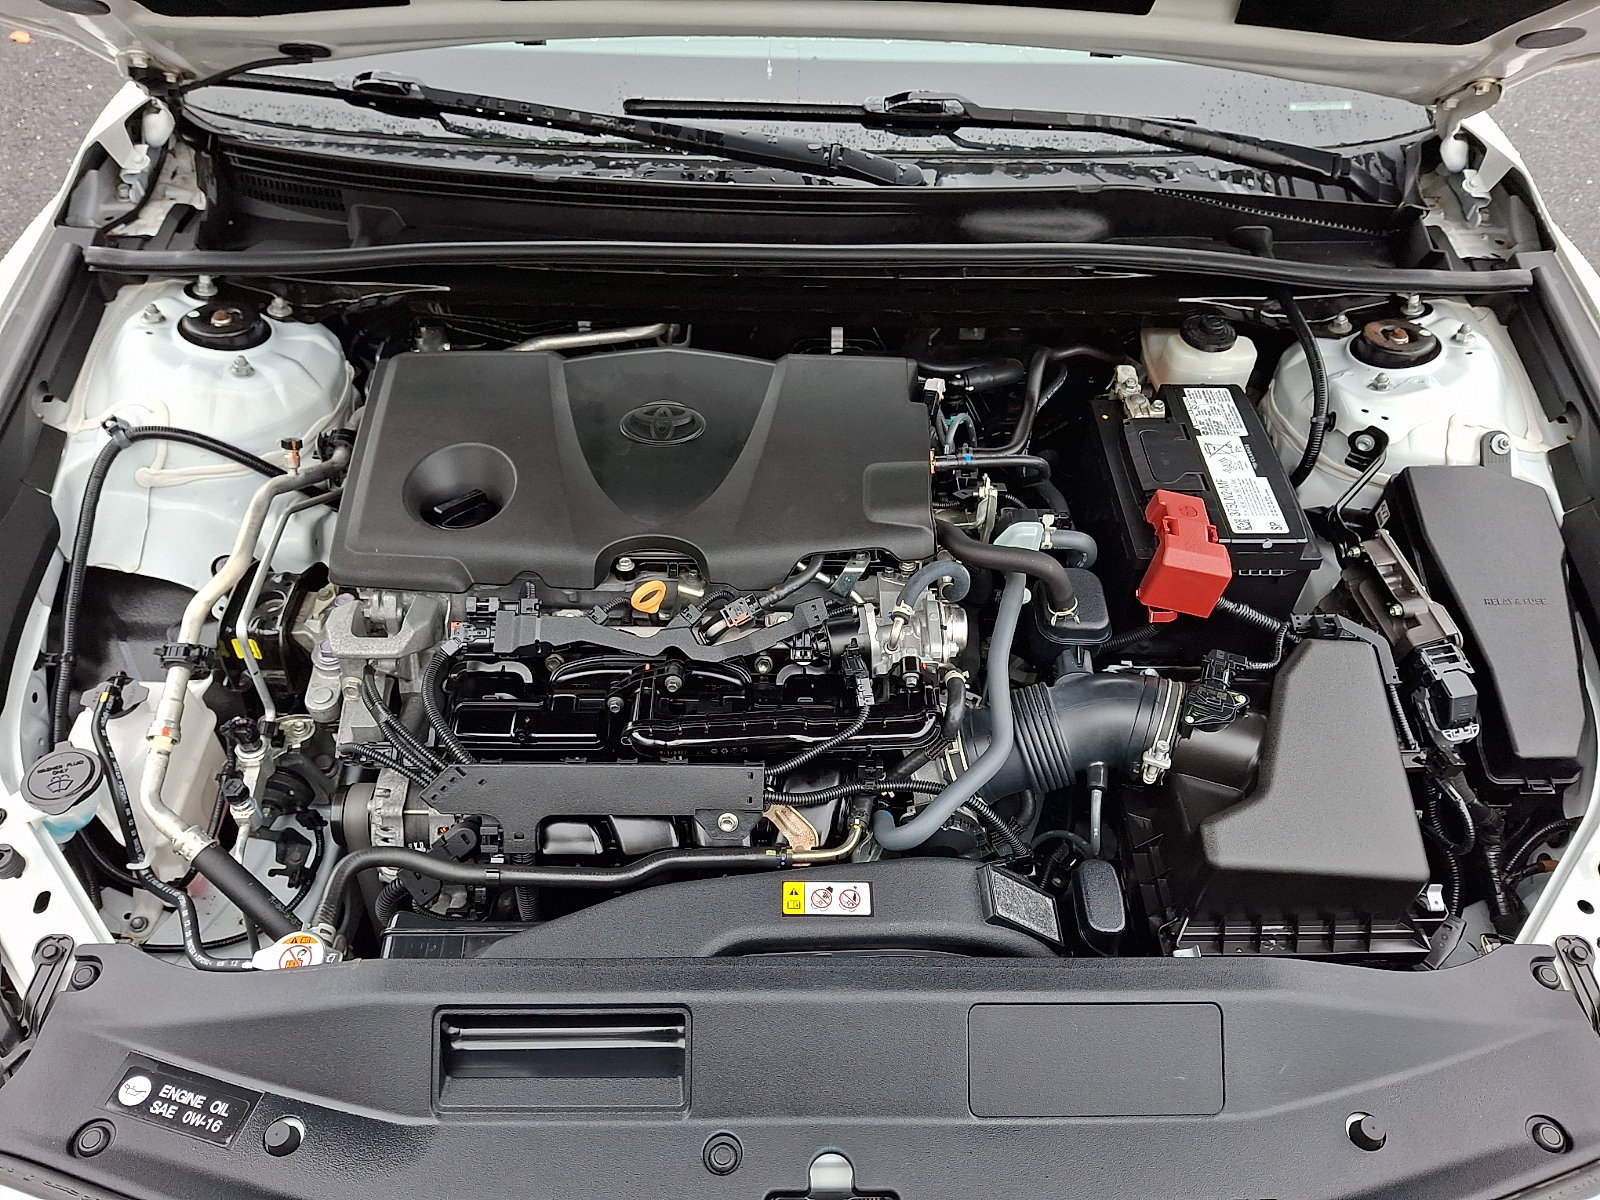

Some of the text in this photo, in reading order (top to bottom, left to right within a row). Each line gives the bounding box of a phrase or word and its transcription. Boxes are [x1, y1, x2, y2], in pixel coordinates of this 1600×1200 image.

[1483, 598, 1513, 606] RELAY
[149, 1100, 224, 1133] SAE 0W-16
[158, 1084, 230, 1118] ENGINE OIL
